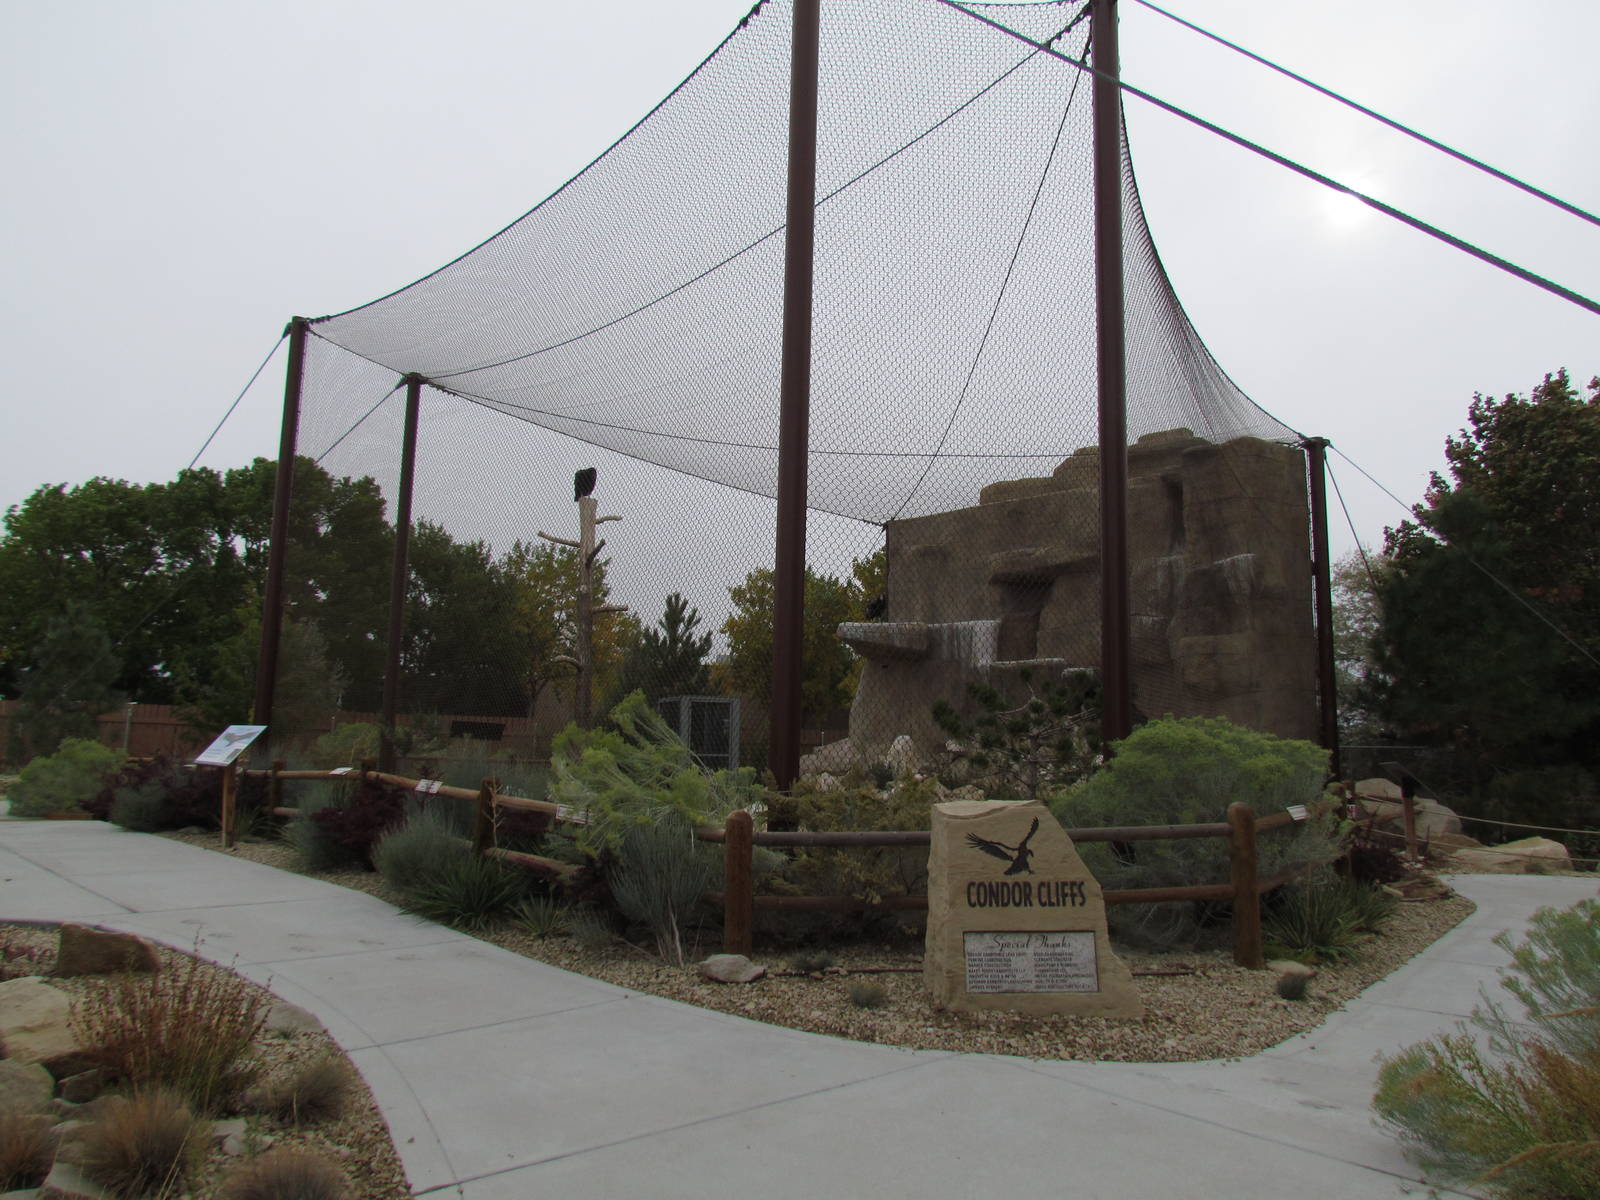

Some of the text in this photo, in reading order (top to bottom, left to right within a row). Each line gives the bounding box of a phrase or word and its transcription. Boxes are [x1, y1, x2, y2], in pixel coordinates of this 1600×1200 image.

[967, 881, 1087, 908] CONDOR CLIFFS
[987, 934, 1071, 952] Special Thanks
